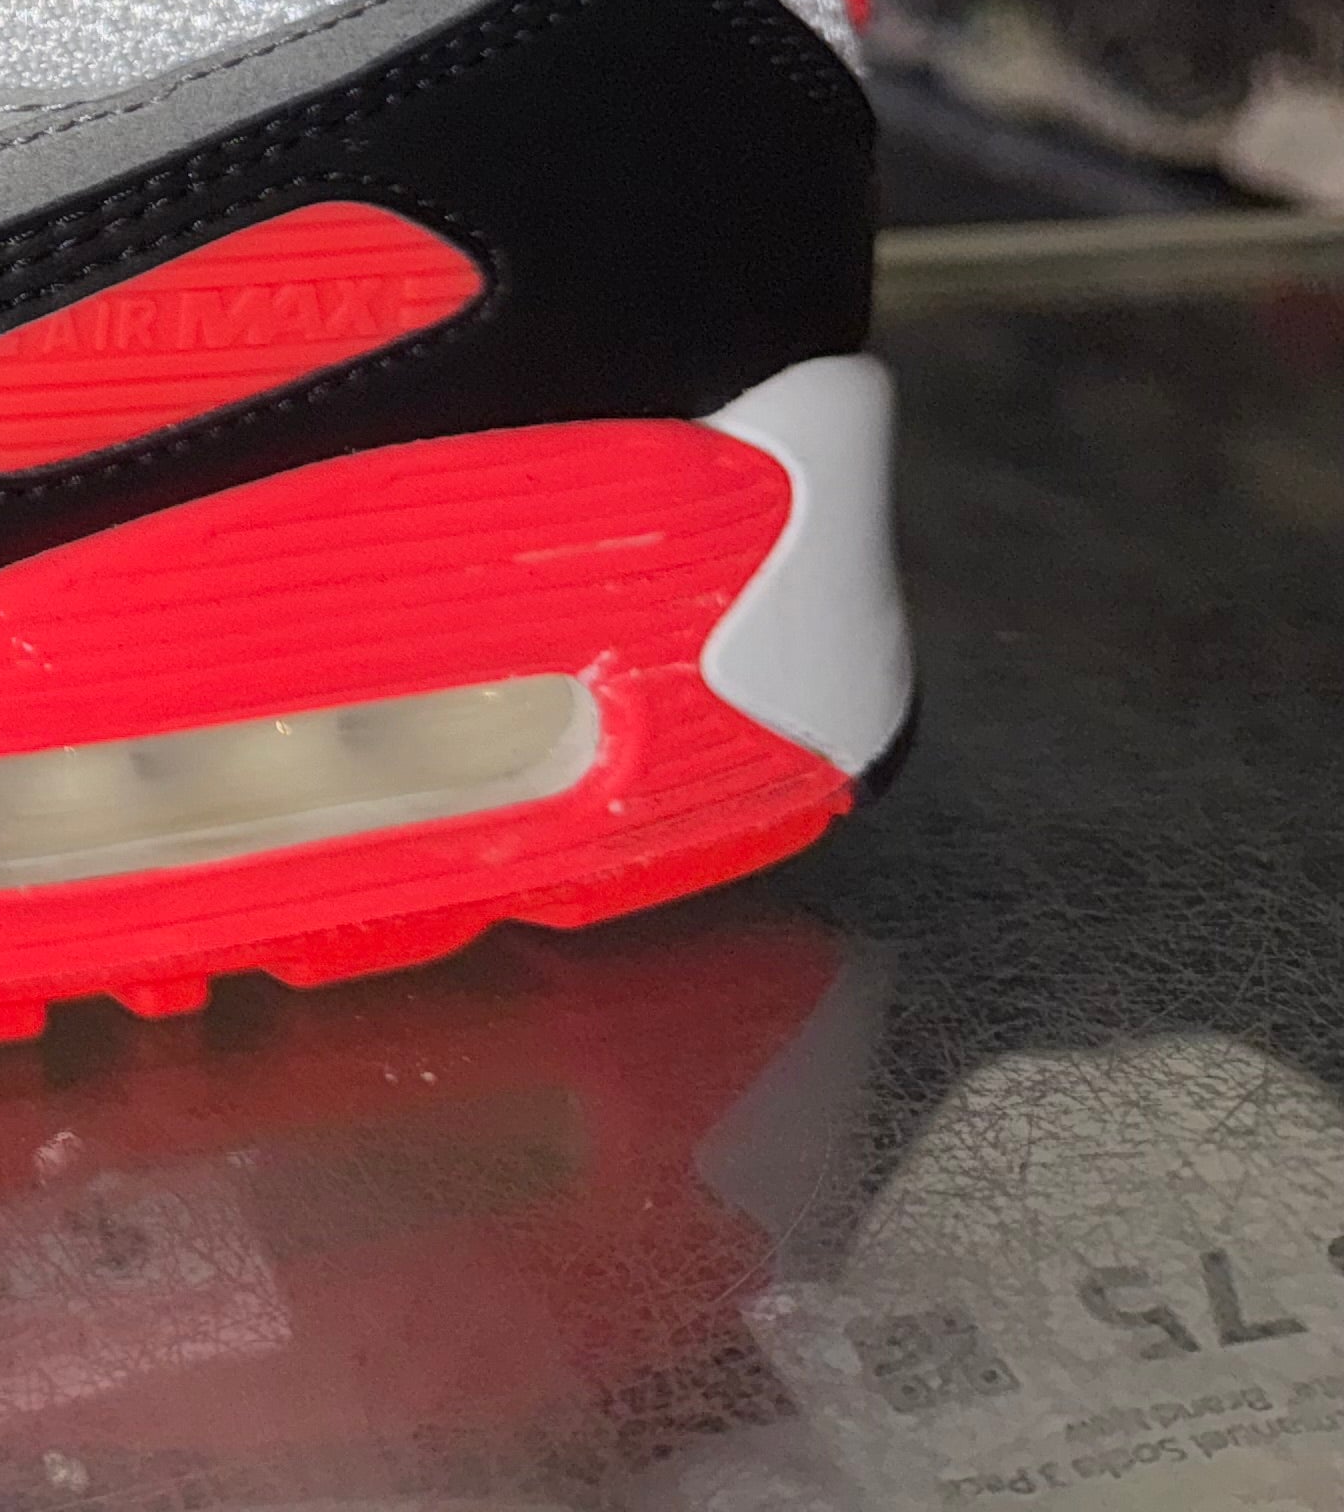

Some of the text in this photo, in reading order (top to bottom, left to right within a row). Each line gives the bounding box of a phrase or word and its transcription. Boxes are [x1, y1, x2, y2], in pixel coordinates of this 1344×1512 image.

[41, 281, 381, 353] AIR MAX
[1078, 1233, 1344, 1361] 75
